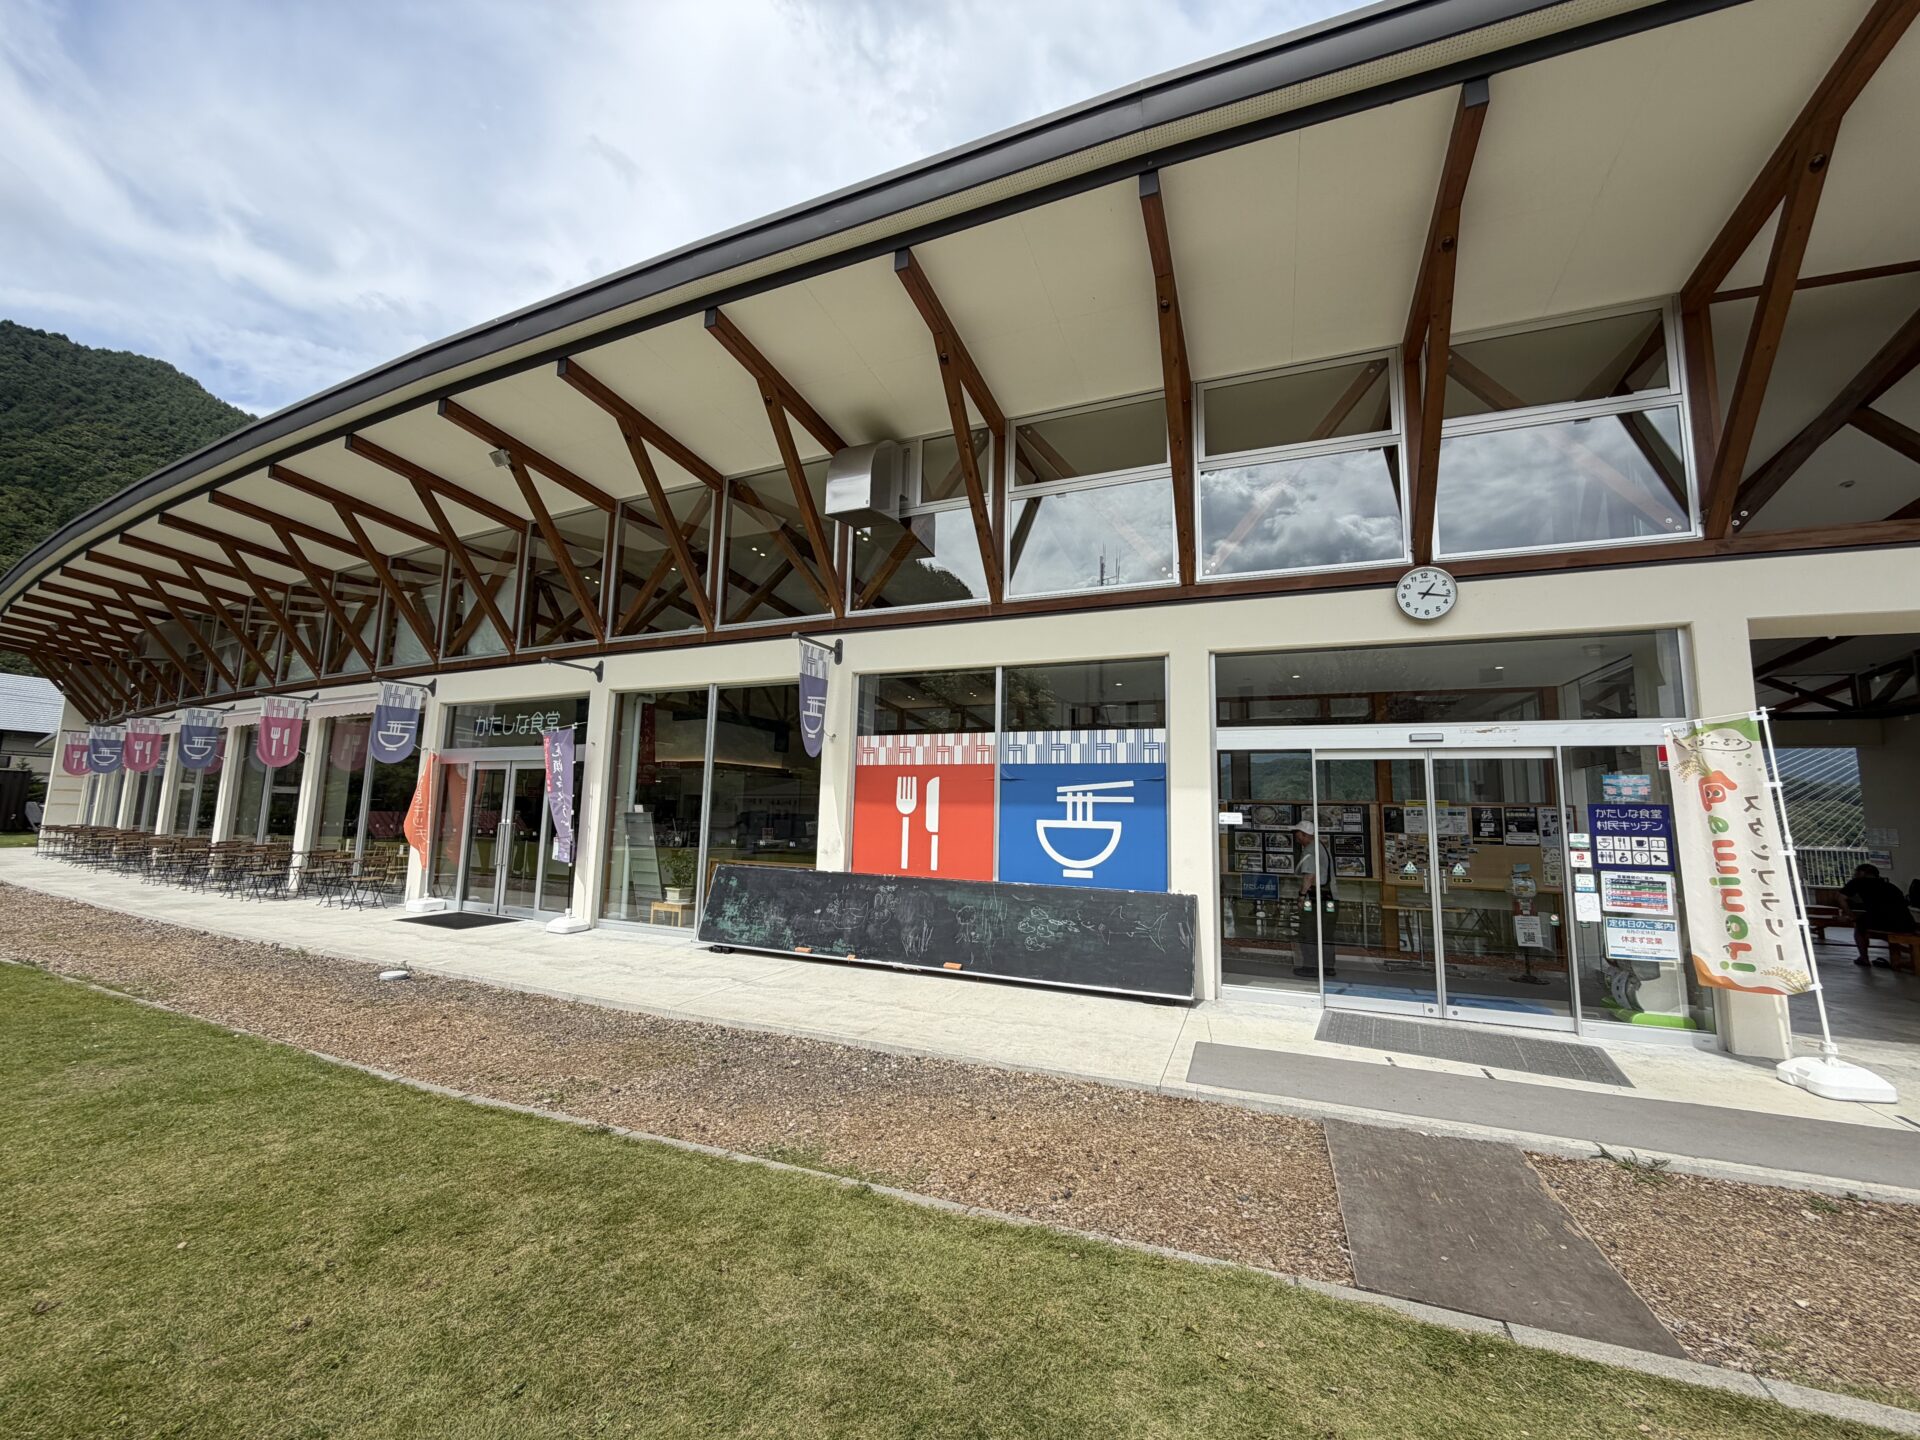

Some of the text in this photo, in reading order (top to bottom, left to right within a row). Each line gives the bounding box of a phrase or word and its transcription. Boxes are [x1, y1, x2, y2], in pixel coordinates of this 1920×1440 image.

[475, 710, 561, 737] かたしな食堂
[1595, 808, 1662, 819] かたしな食堂
[1596, 820, 1663, 831] 村民キッチン
[1608, 919, 1674, 931] 定休日のご案内
[1621, 935, 1663, 945] 休まず営業
